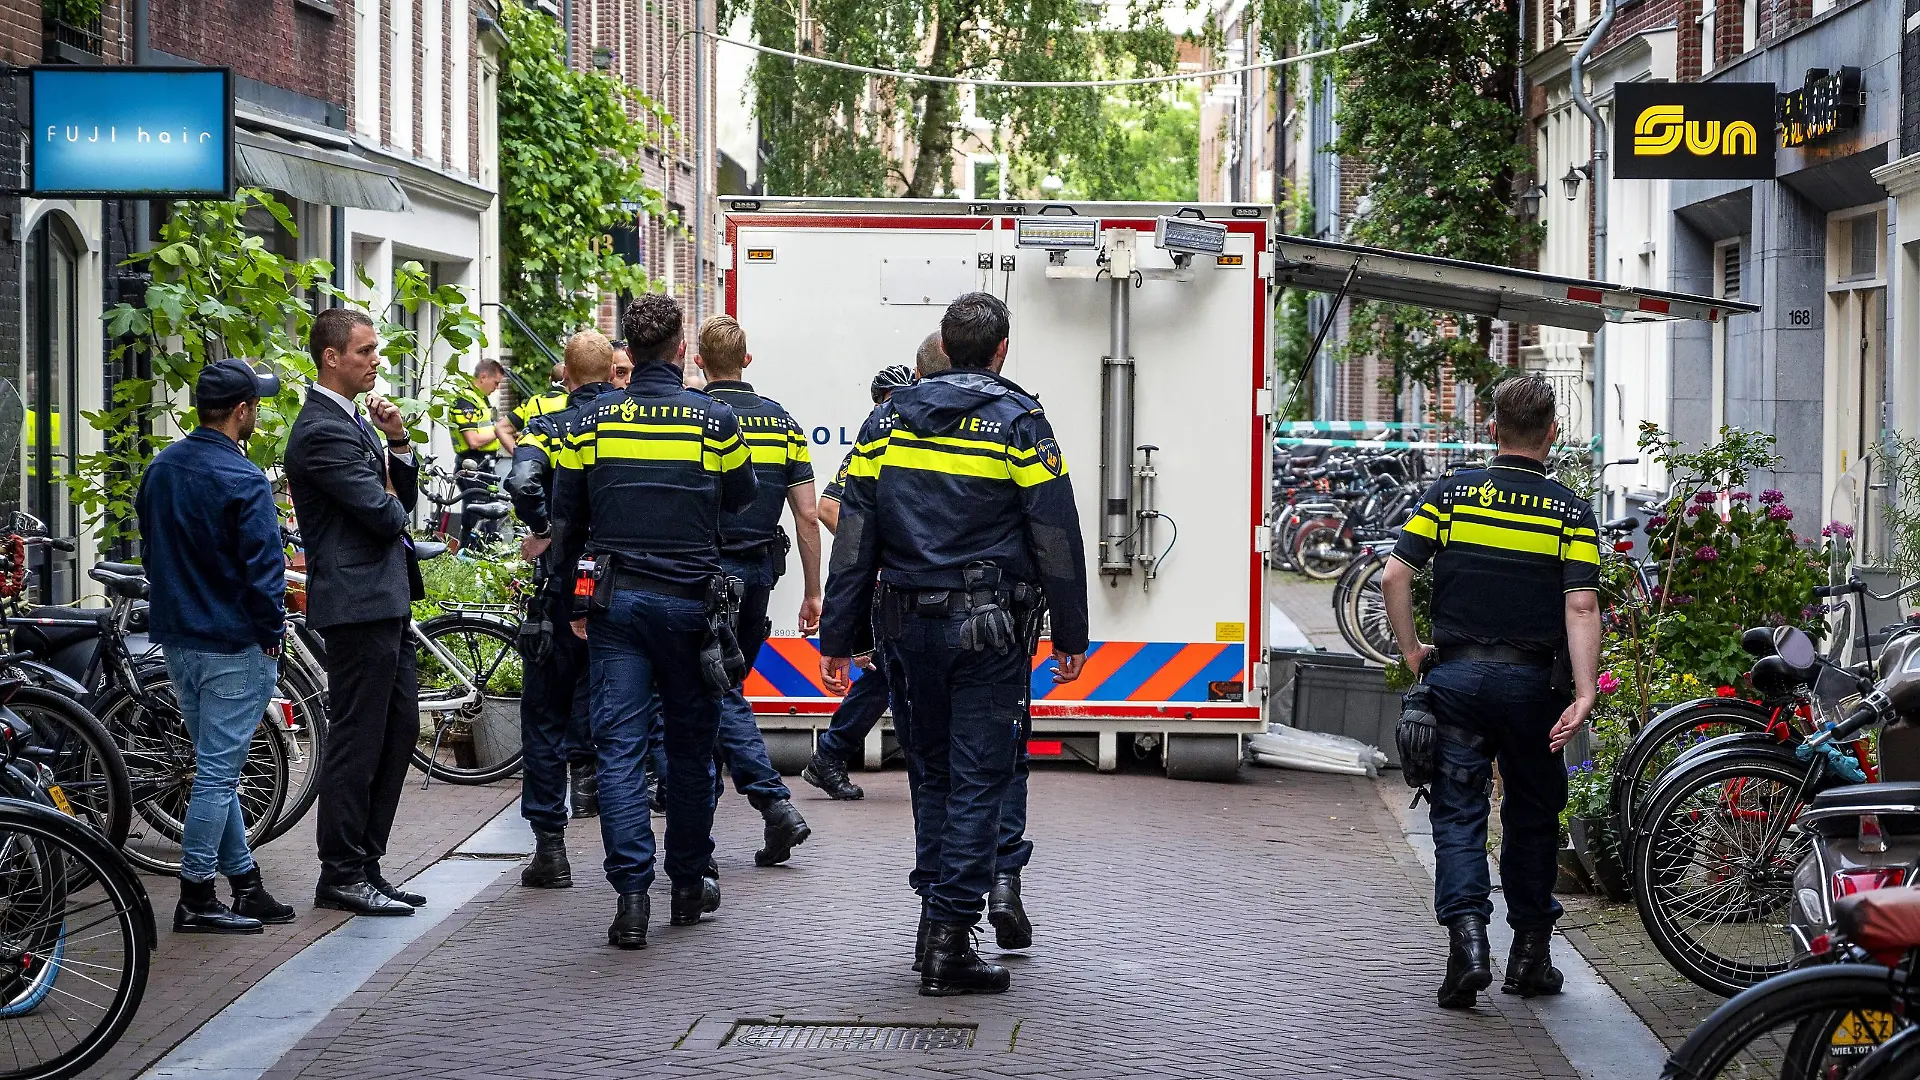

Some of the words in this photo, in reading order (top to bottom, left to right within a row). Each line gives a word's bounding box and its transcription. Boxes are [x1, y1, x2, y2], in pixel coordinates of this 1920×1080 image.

[47, 125, 116, 143] FUJI
[137, 126, 211, 143] hair
[1634, 105, 1757, 156] Sun
[1789, 309, 1810, 325] 168
[739, 415, 778, 428] LITIE
[1831, 1046, 1852, 1056] WIEL
[1854, 1045, 1869, 1054] TOT
